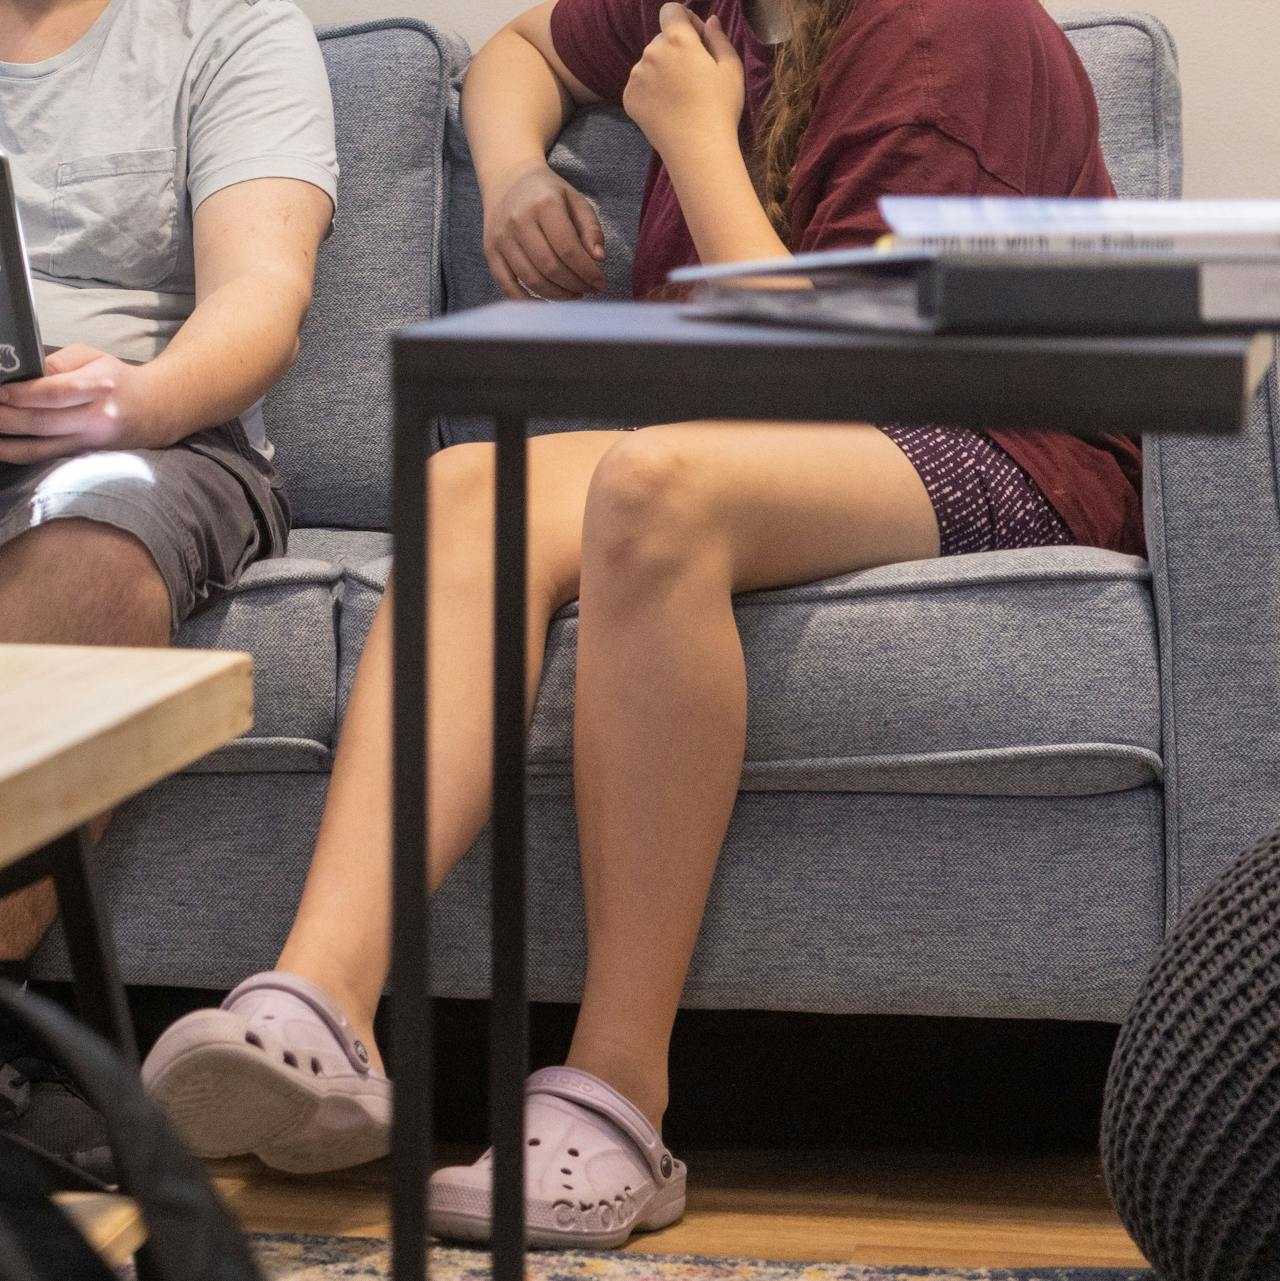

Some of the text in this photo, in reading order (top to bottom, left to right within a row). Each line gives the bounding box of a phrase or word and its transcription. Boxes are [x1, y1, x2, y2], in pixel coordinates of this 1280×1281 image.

[969, 235, 996, 252] THE
[1004, 235, 1050, 252] WILD
[552, 1186, 636, 1232] crocs
